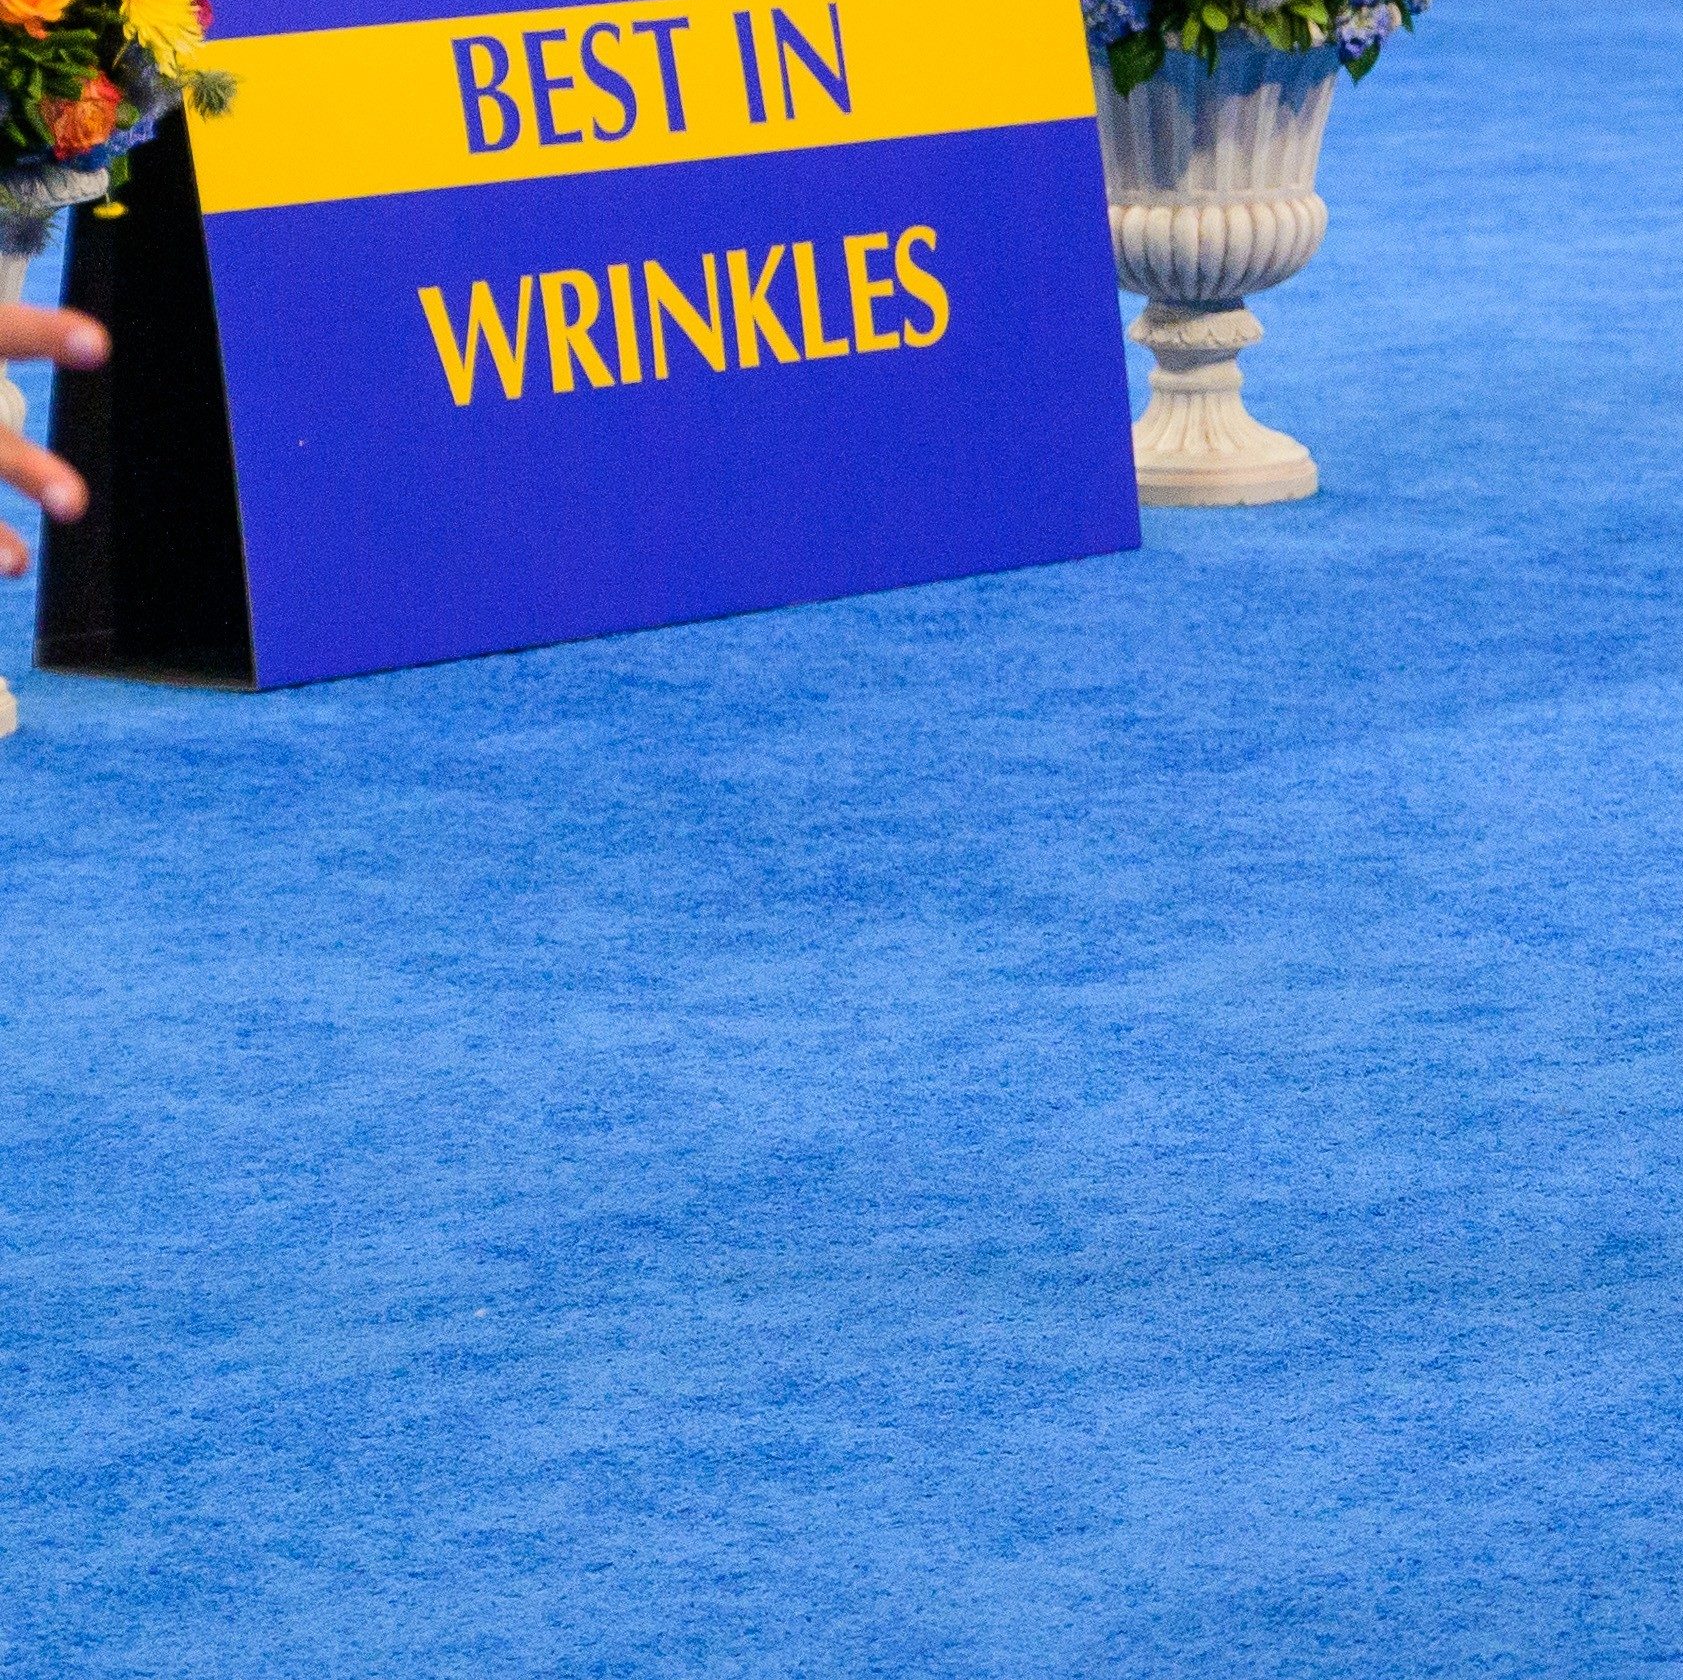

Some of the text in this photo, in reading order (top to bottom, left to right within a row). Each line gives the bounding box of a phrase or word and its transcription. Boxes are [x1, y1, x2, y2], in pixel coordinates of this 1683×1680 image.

[451, 2, 853, 155] BEST IN
[417, 224, 951, 407] WRINKLES
